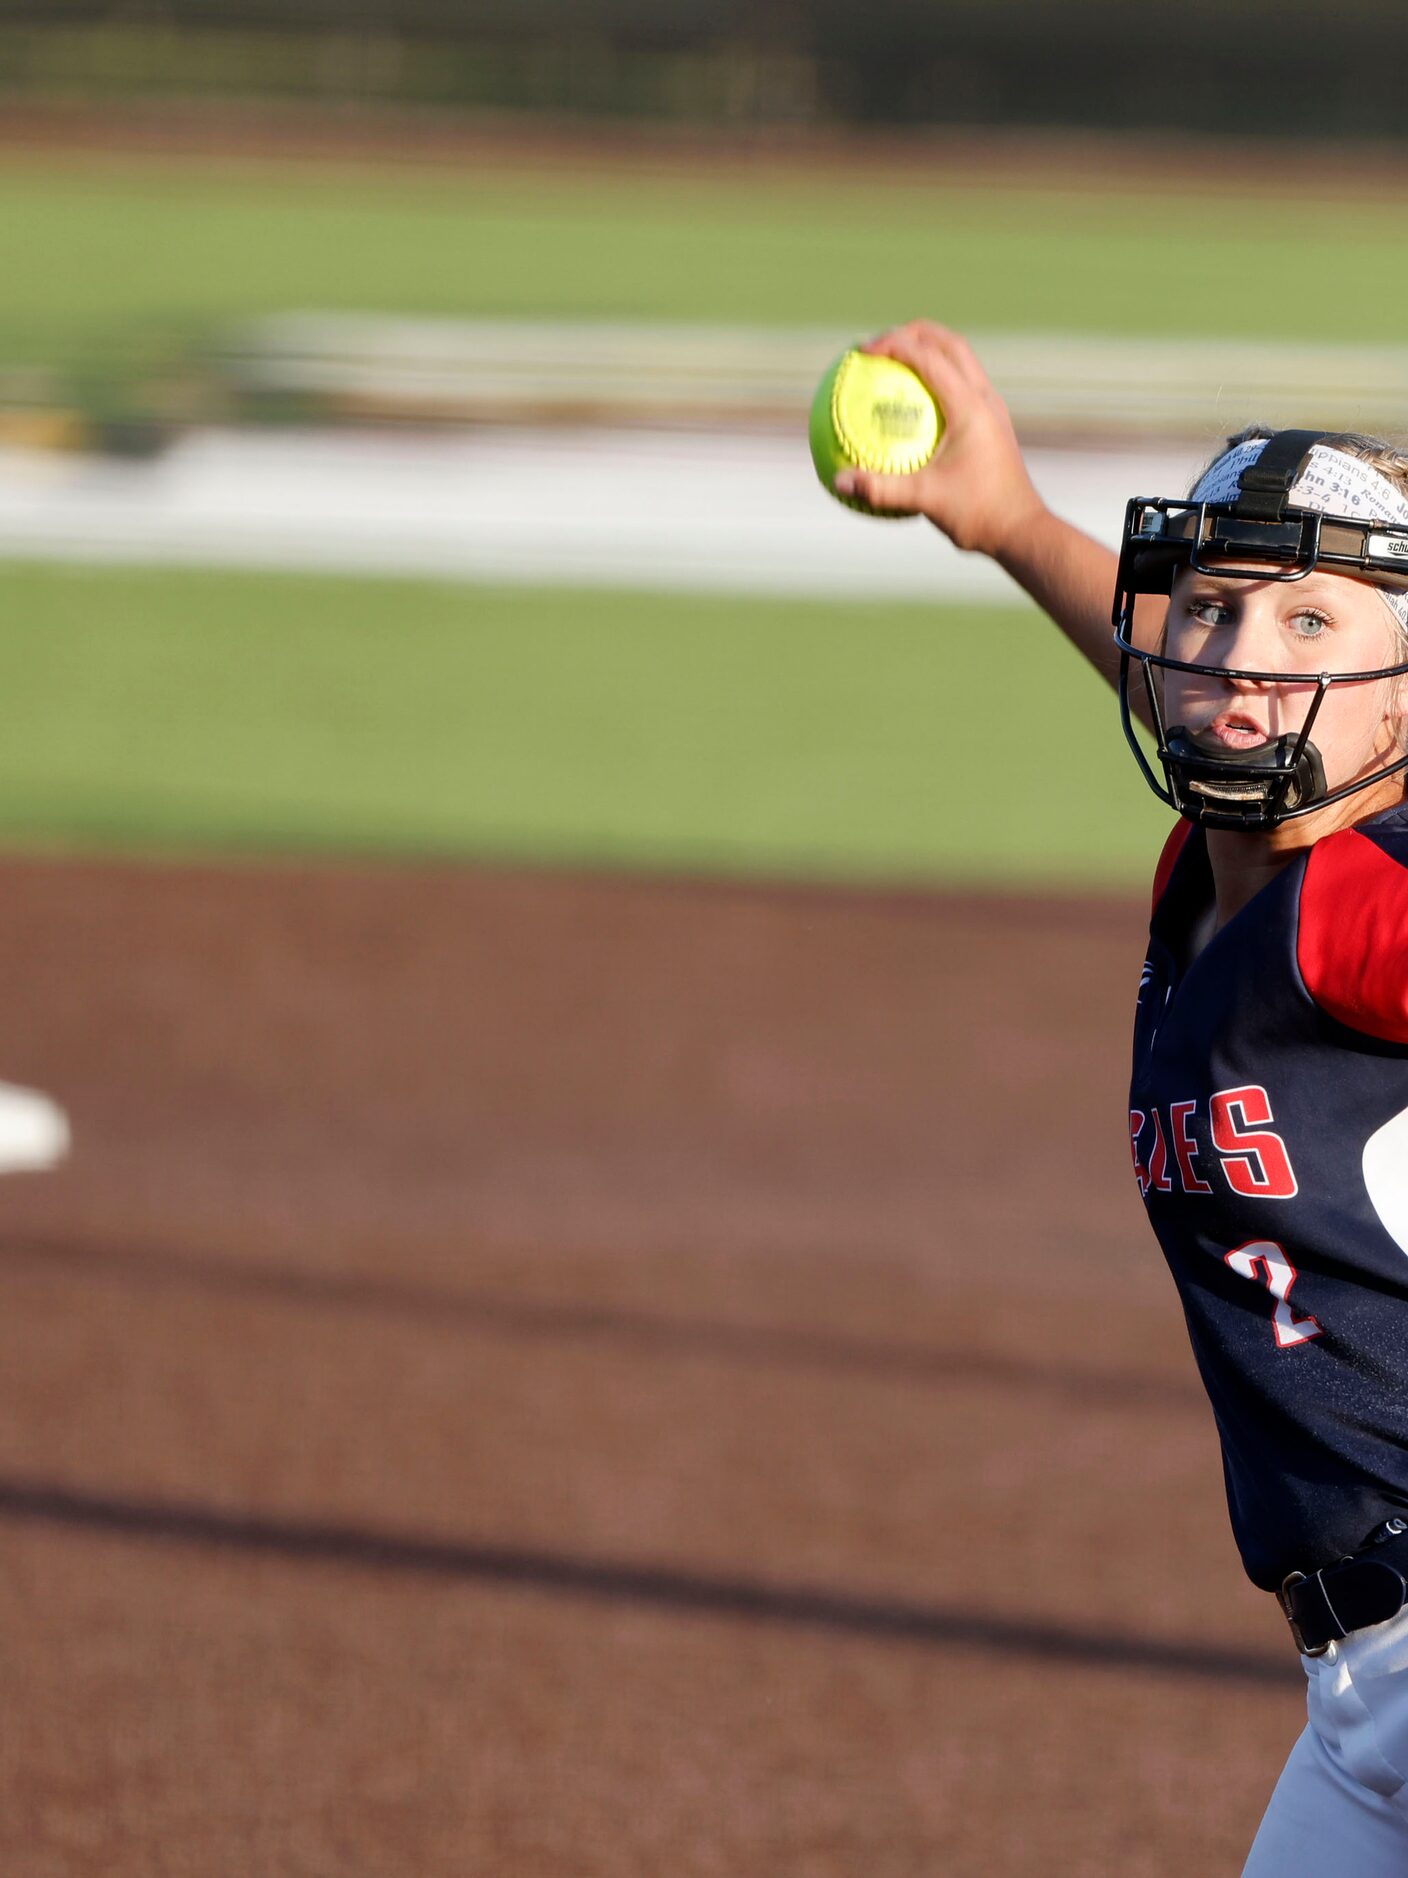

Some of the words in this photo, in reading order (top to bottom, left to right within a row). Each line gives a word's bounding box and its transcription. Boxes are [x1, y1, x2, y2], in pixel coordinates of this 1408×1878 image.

[1329, 482, 1361, 506] 3:16
[1361, 488, 1398, 524] Roman
[1224, 1239, 1324, 1348] 2
